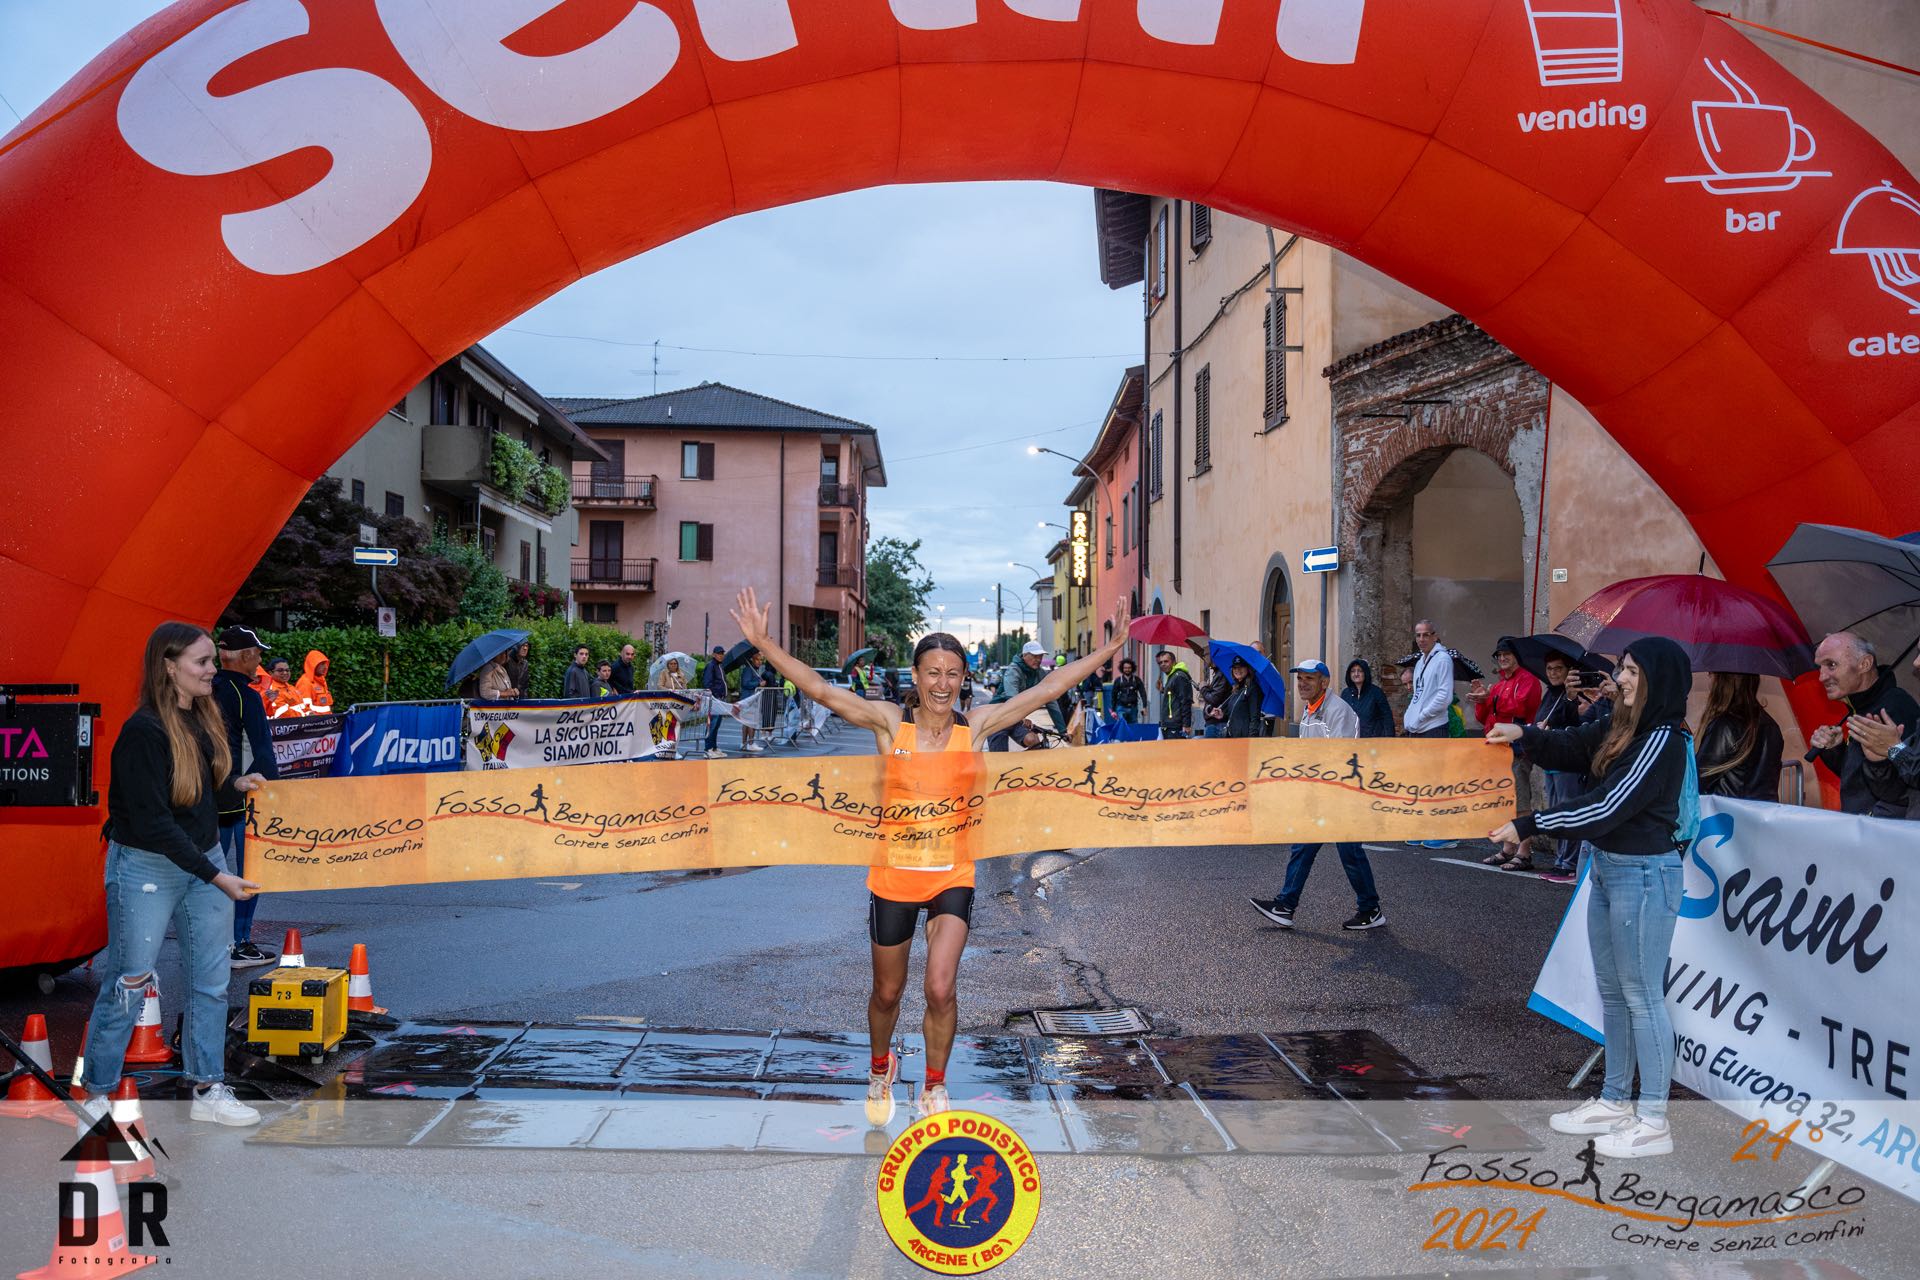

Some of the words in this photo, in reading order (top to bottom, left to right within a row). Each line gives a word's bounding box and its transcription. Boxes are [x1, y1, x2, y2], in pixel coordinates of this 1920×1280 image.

[1517, 99, 1647, 133] vending
[1724, 208, 1781, 233] bar
[1073, 512, 1087, 538] BAR
[556, 710, 584, 724] DAL
[590, 706, 618, 722] 1920
[535, 729, 551, 744] LA
[556, 721, 635, 744] SICUREZZA
[543, 742, 592, 762] SIAMO
[594, 740, 622, 758] NOI.
[0, 768, 50, 780] TIONS
[1256, 756, 1338, 781] Fosso
[1368, 771, 1513, 806] Bergamasco
[994, 767, 1072, 791] Fosso
[1099, 776, 1246, 810] Bergamasco
[435, 791, 521, 815] Fosso
[552, 803, 706, 838] Bergamasco
[716, 778, 798, 802] Fosso
[830, 792, 984, 828] Bergamasco
[1098, 806, 1149, 822] Correre
[1154, 809, 1195, 822] senza
[1199, 800, 1247, 818] confini
[1371, 800, 1424, 816] Correre
[1430, 803, 1468, 816] senza
[1472, 794, 1515, 811] confini
[263, 817, 423, 853] Bergamasco
[554, 834, 609, 849] Correre
[615, 836, 656, 849] senza
[661, 822, 709, 842] confini
[833, 822, 886, 841] Correre
[892, 827, 933, 842] senza
[937, 813, 984, 837] confini
[264, 849, 320, 864] Correre
[326, 851, 369, 864] senza
[372, 837, 424, 858] confini
[1679, 812, 1895, 974] Scaini
[276, 991, 293, 1001] 73
[1821, 1016, 1911, 1101] TRE
[1673, 1031, 1707, 1068] rso
[1709, 1045, 1811, 1118] Europa
[1806, 1101, 1857, 1144] 32,
